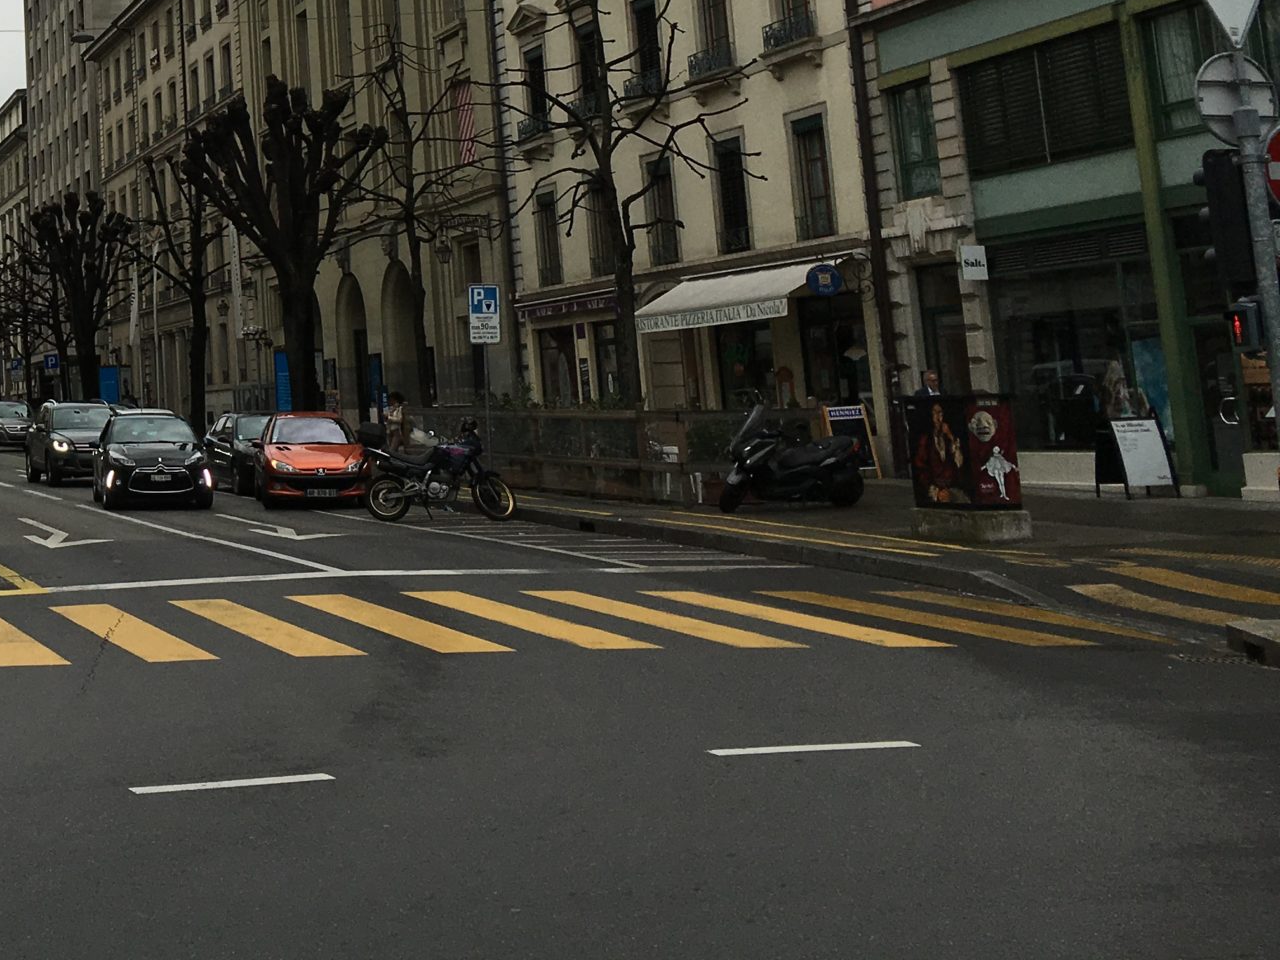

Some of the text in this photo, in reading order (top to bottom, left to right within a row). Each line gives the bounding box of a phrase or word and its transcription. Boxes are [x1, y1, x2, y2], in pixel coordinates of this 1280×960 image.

[963, 258, 986, 268] Salt.
[473, 288, 485, 305] P
[636, 314, 680, 331] RISTORANTE
[680, 309, 714, 327] PIZZERIA
[715, 306, 742, 323] ITALIA
[480, 322, 490, 330] 90
[47, 356, 56, 368] P
